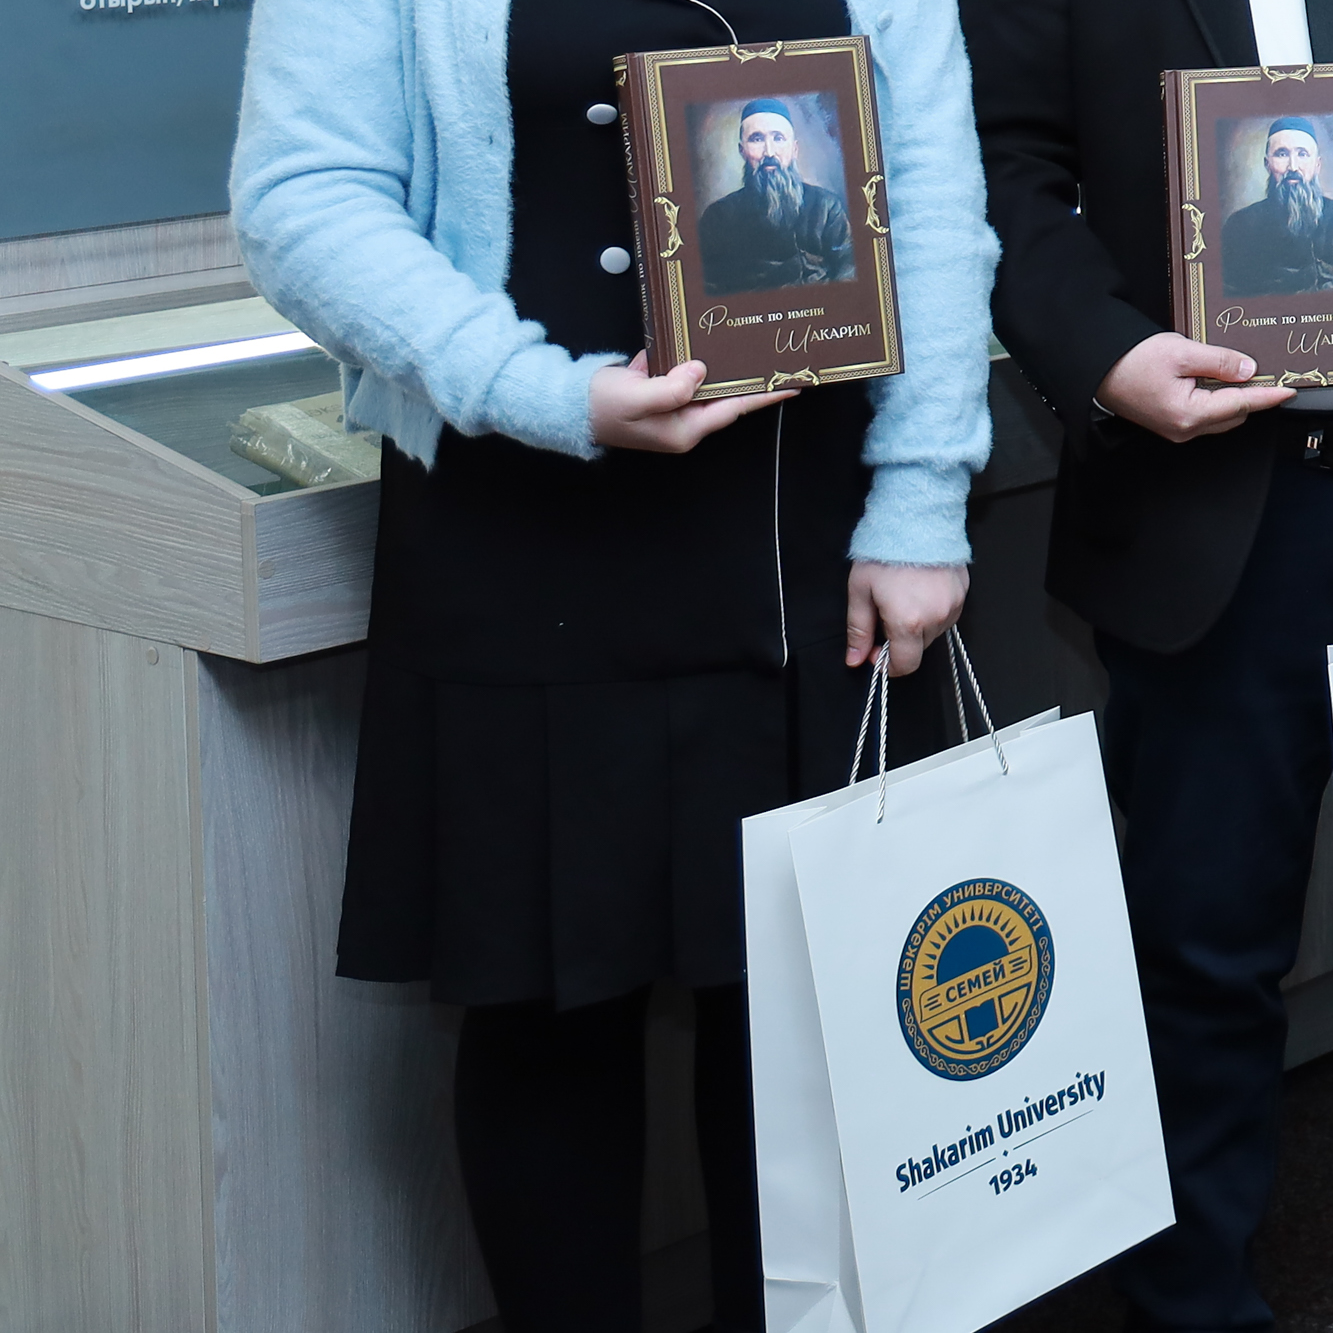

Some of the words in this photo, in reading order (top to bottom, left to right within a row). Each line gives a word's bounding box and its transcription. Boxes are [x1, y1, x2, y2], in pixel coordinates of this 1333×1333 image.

[699, 305, 763, 334] Родник
[768, 310, 783, 322] по
[788, 306, 825, 321] имени
[1216, 305, 1277, 333] Родник
[1281, 315, 1296, 324] по
[774, 323, 871, 354] ШАКАРИМ
[900, 903, 941, 990] ШӘКӘРІМ
[943, 882, 1042, 932] УНИВЕРСИТЕТІ
[945, 959, 1006, 1003] СЕМЕЙ
[895, 1125, 995, 1194] Shakarim
[997, 1069, 1105, 1139] University
[988, 1159, 1038, 1195] 1934
